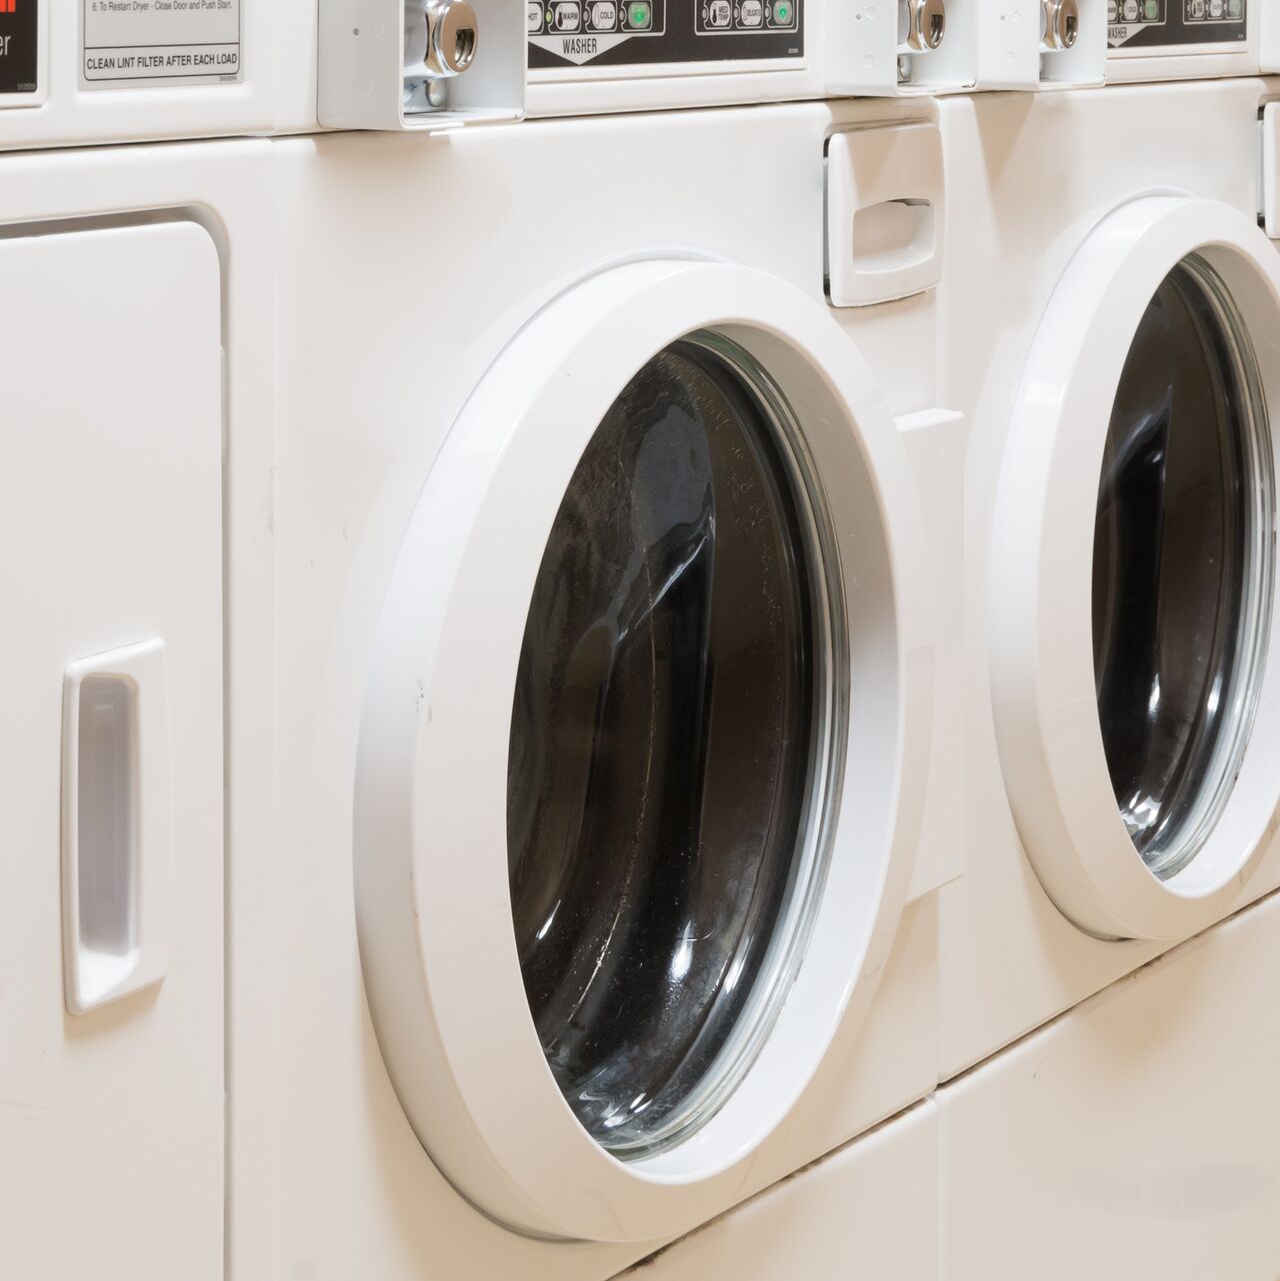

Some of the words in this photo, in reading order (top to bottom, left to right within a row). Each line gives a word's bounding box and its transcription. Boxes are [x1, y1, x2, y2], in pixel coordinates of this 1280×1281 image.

[99, 2, 107, 11] To
[108, 1, 132, 11] Restart
[132, 1, 149, 13] Dryer
[154, 0, 172, 11] Close
[173, 0, 188, 10] Door
[188, 0, 201, 10] and
[201, 0, 216, 9] Push
[217, 0, 232, 10] Start.
[600, 11, 614, 20] COLD
[562, 38, 598, 55] WASHER
[86, 57, 115, 70] CLEAN
[117, 57, 136, 69] LINT
[136, 55, 164, 68] FILTER
[165, 54, 192, 67] AFTER
[193, 53, 215, 66] EACH
[216, 52, 238, 65] LOAD
